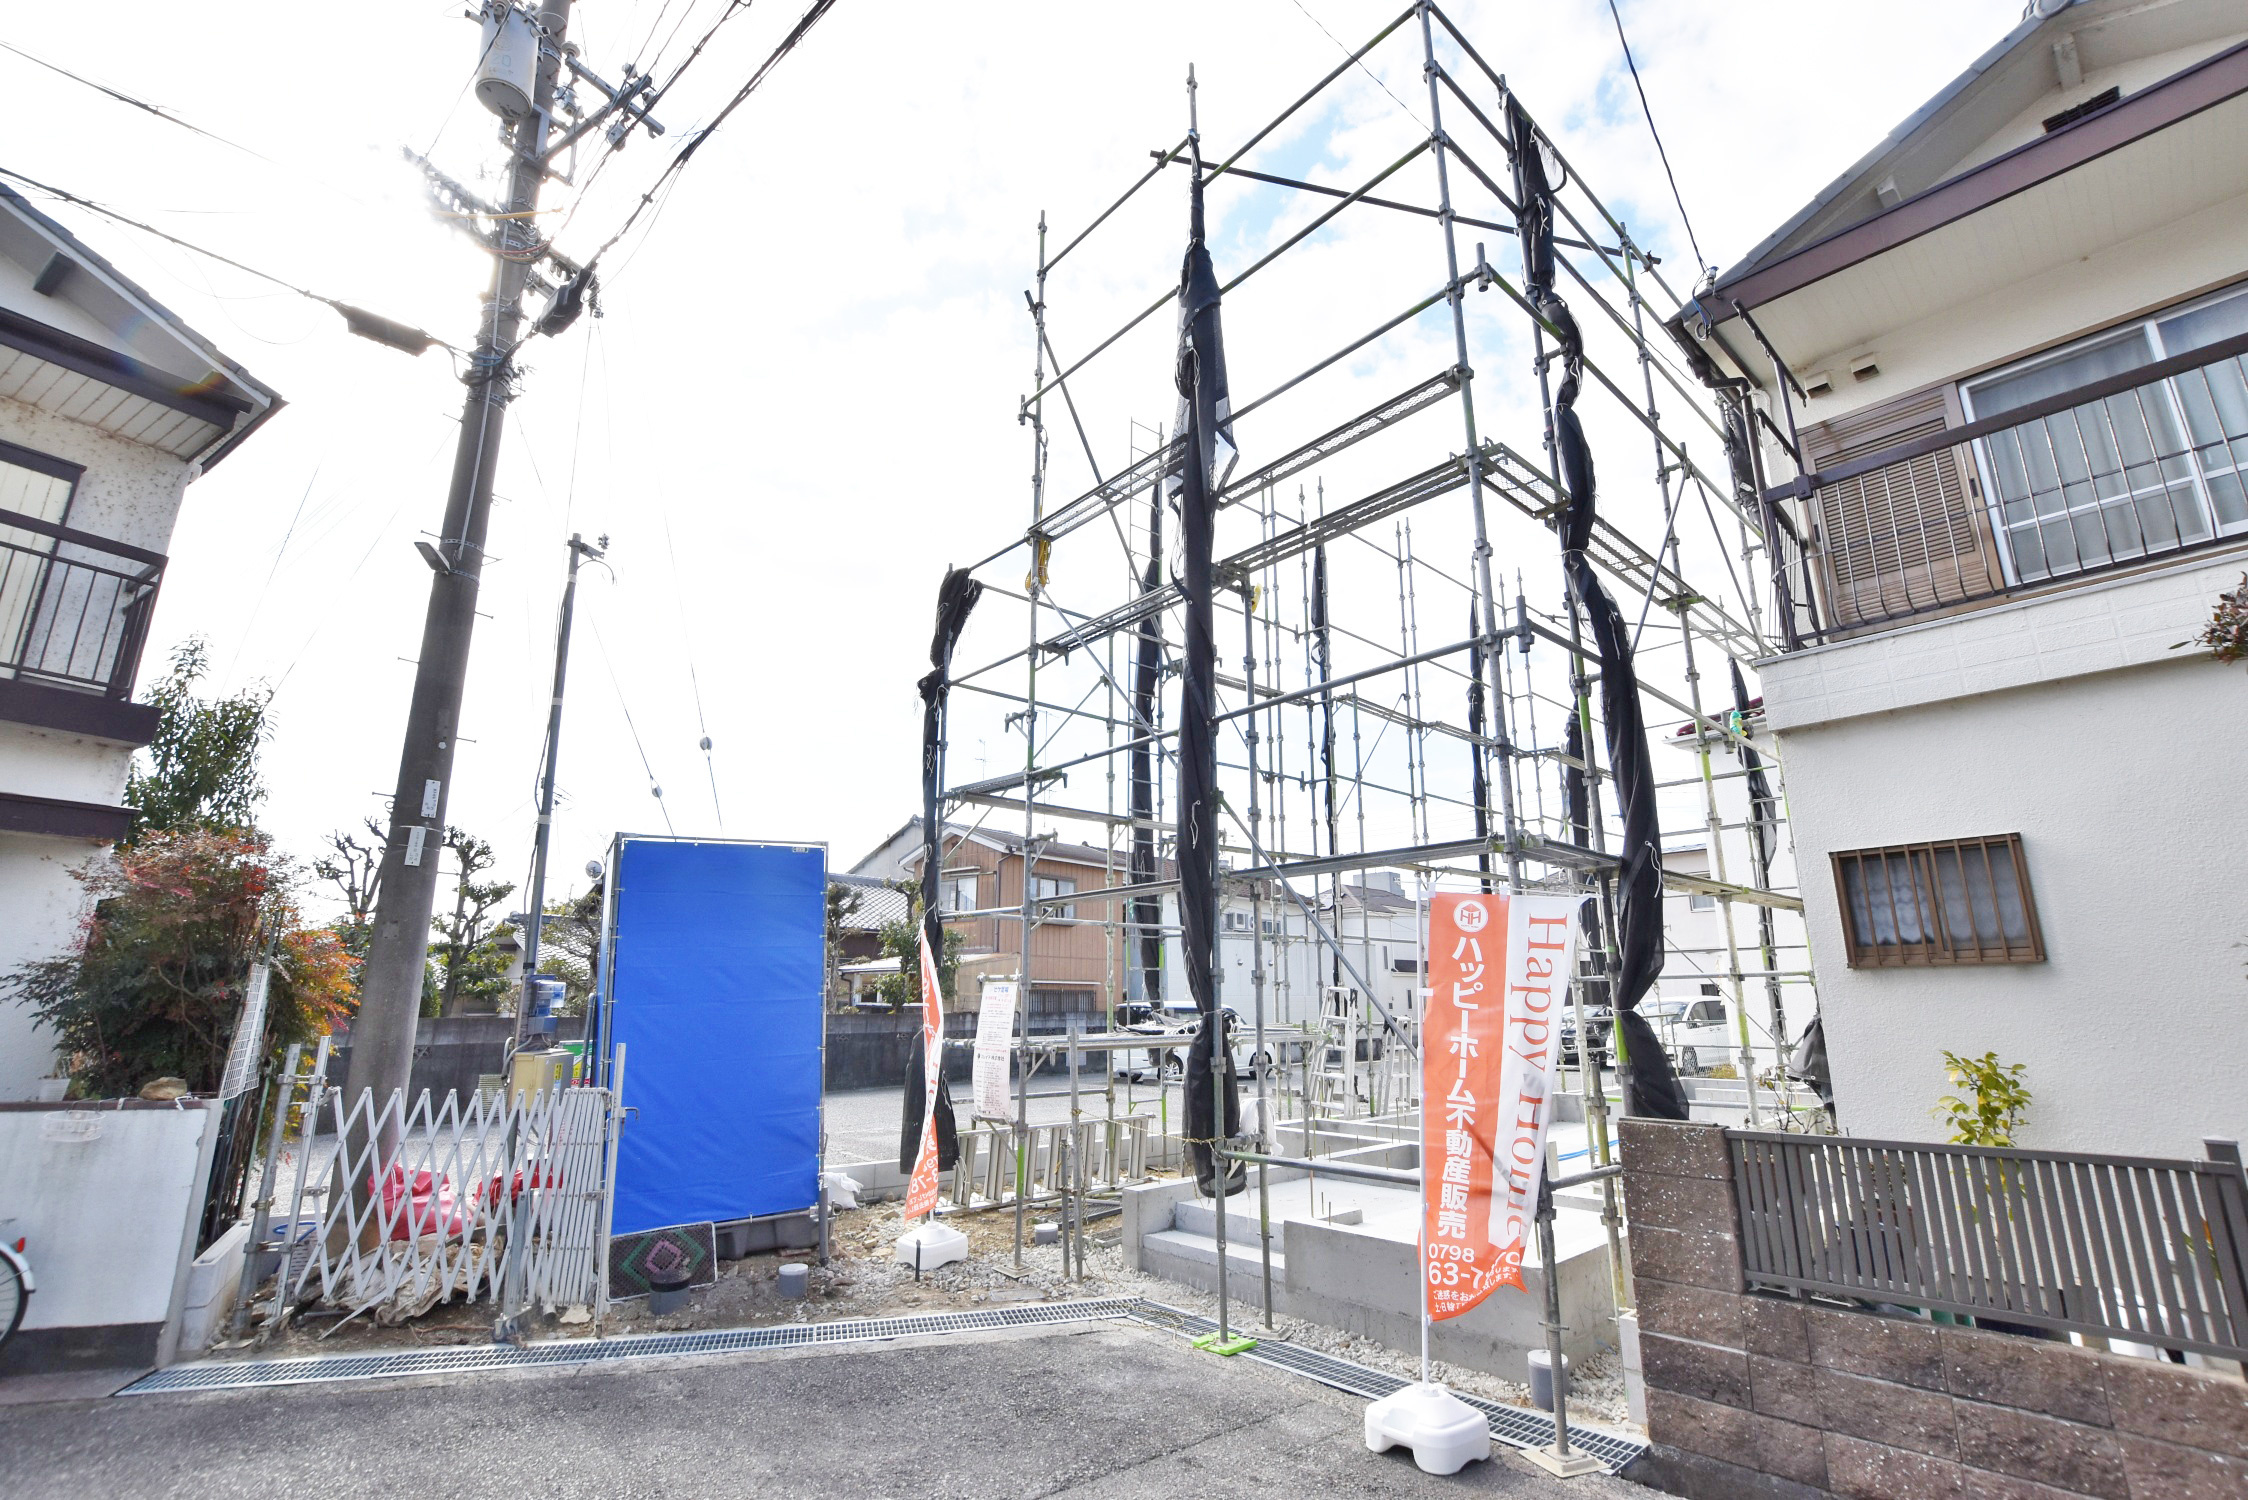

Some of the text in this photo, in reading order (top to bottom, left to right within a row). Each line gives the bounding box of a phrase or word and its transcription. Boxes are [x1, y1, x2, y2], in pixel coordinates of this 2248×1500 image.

[1508, 913, 1568, 1073] Happy
[1437, 936, 1485, 1239] ハッピーホーム不動産販売
[1428, 1243, 1475, 1263] 0798
